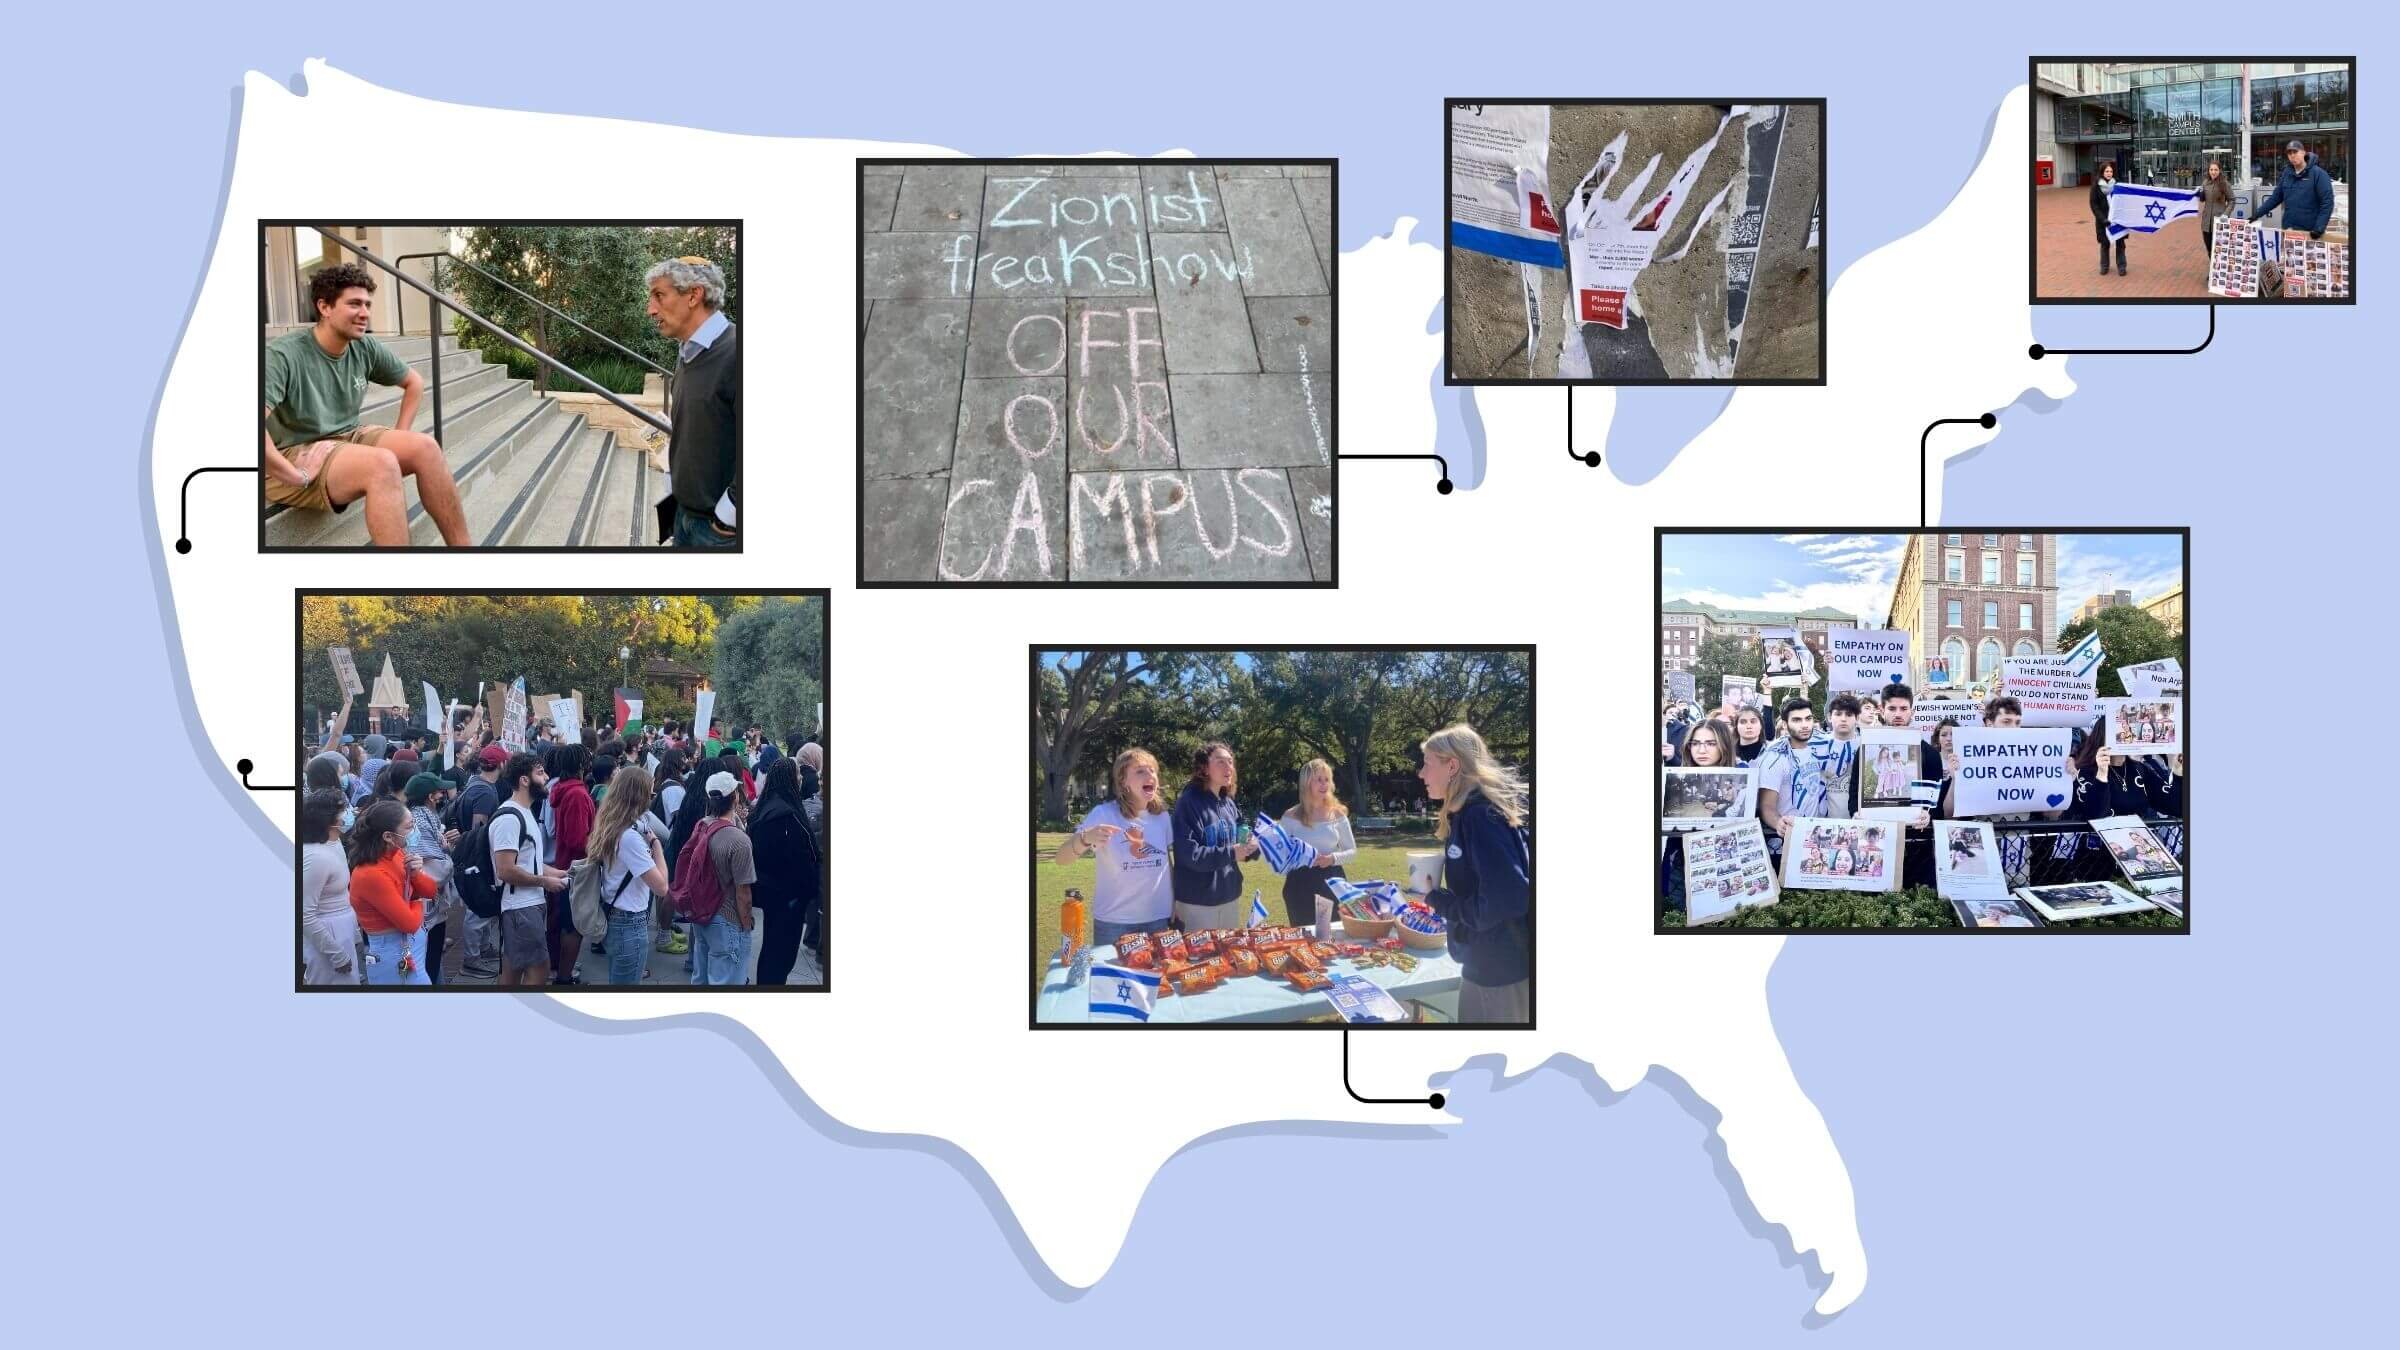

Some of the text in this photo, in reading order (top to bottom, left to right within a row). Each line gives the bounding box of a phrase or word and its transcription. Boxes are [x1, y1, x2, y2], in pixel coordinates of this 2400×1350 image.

[2168, 111, 2200, 121] SMITH
[2168, 121, 2200, 129] CAMPUS
[2168, 128, 2200, 136] CENTER
[990, 171, 1212, 227] Zionist
[1591, 295, 1620, 304] Please
[1591, 305, 1616, 313] home
[1007, 306, 1165, 377] OFF
[1004, 381, 1177, 464] OUR
[939, 467, 1293, 580] CAMPUS
[1834, 640, 1904, 651] EMPATHY ON
[1834, 655, 1904, 664] OUR CAMPUS
[1857, 669, 1882, 678] NOW
[2019, 667, 2035, 676] THE
[2036, 669, 2072, 677] MURDER
[2008, 678, 2092, 689] INNOCENT CIVILIANS
[2151, 674, 2166, 683] Noa
[2009, 689, 2027, 697] YOU
[2061, 693, 2089, 701] STAND
[1913, 703, 1979, 712] JEWISH WOMEN'S
[2023, 702, 2055, 710] HUMAN
[1914, 714, 1943, 722] BODIES
[1963, 744, 2063, 757] EMPATHY ON
[1963, 766, 2063, 779] OUR CAMPUS
[1997, 788, 2035, 801] NOW
